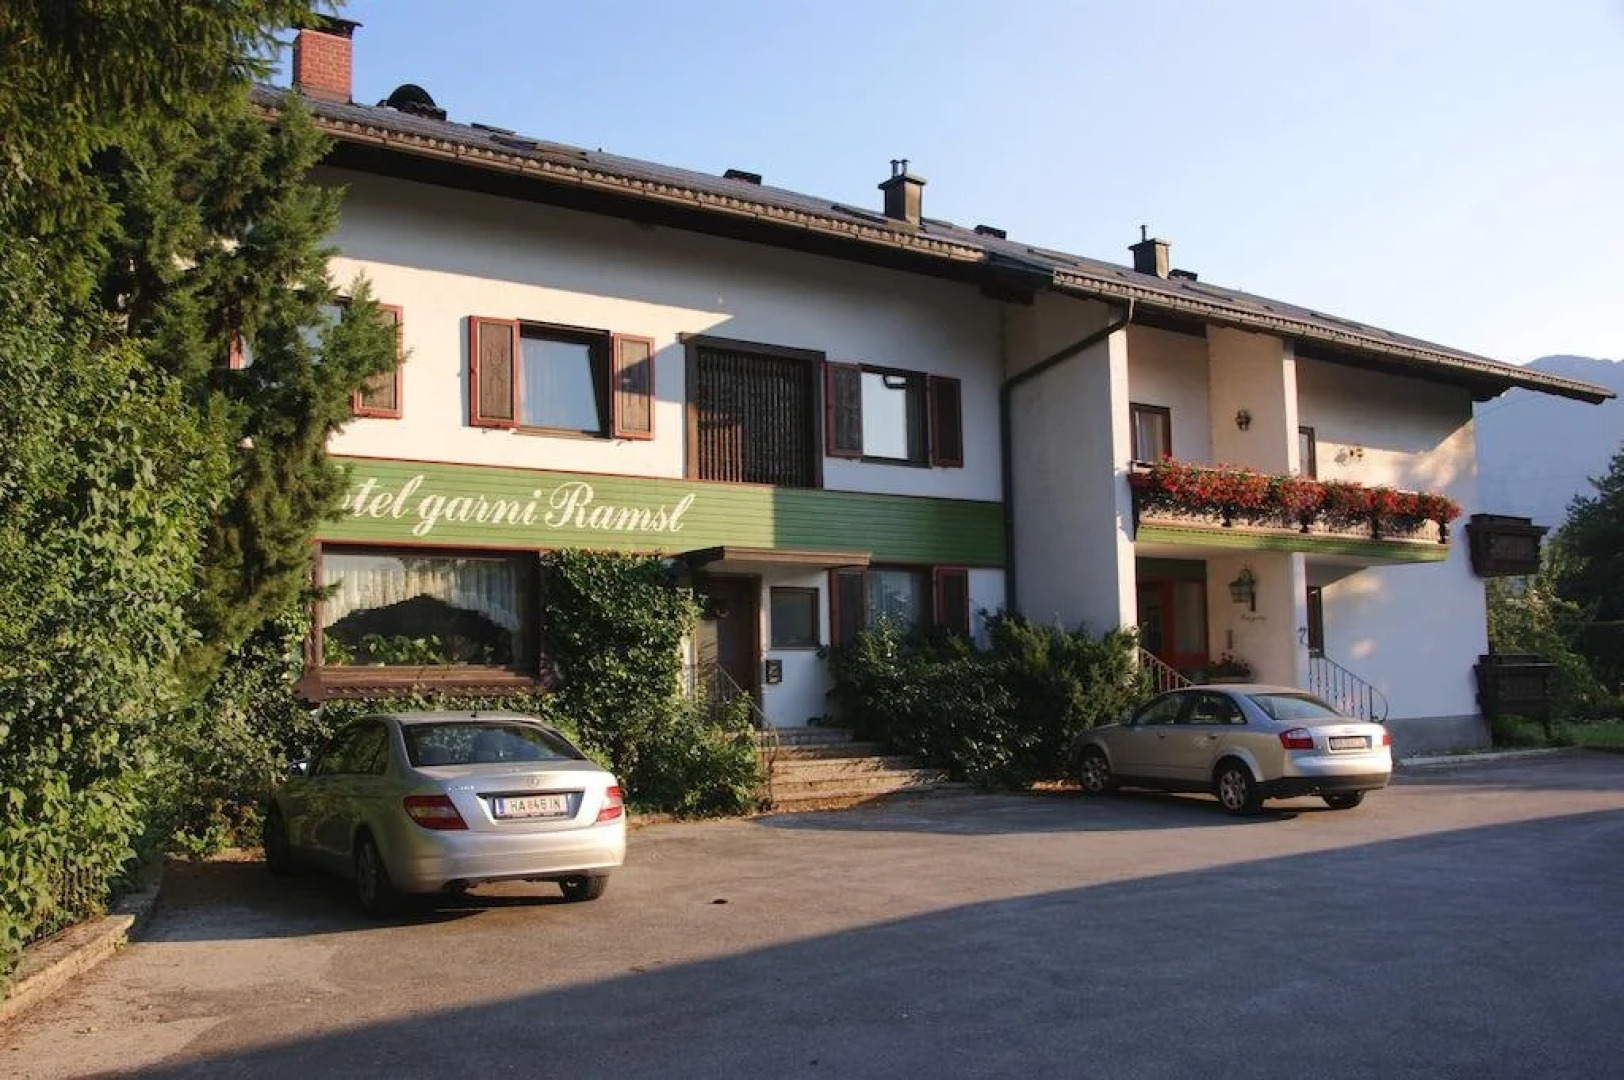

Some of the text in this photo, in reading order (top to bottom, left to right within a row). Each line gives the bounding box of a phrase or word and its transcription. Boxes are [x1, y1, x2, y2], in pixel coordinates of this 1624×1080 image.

[335, 465, 696, 536] tel garni Ramsl
